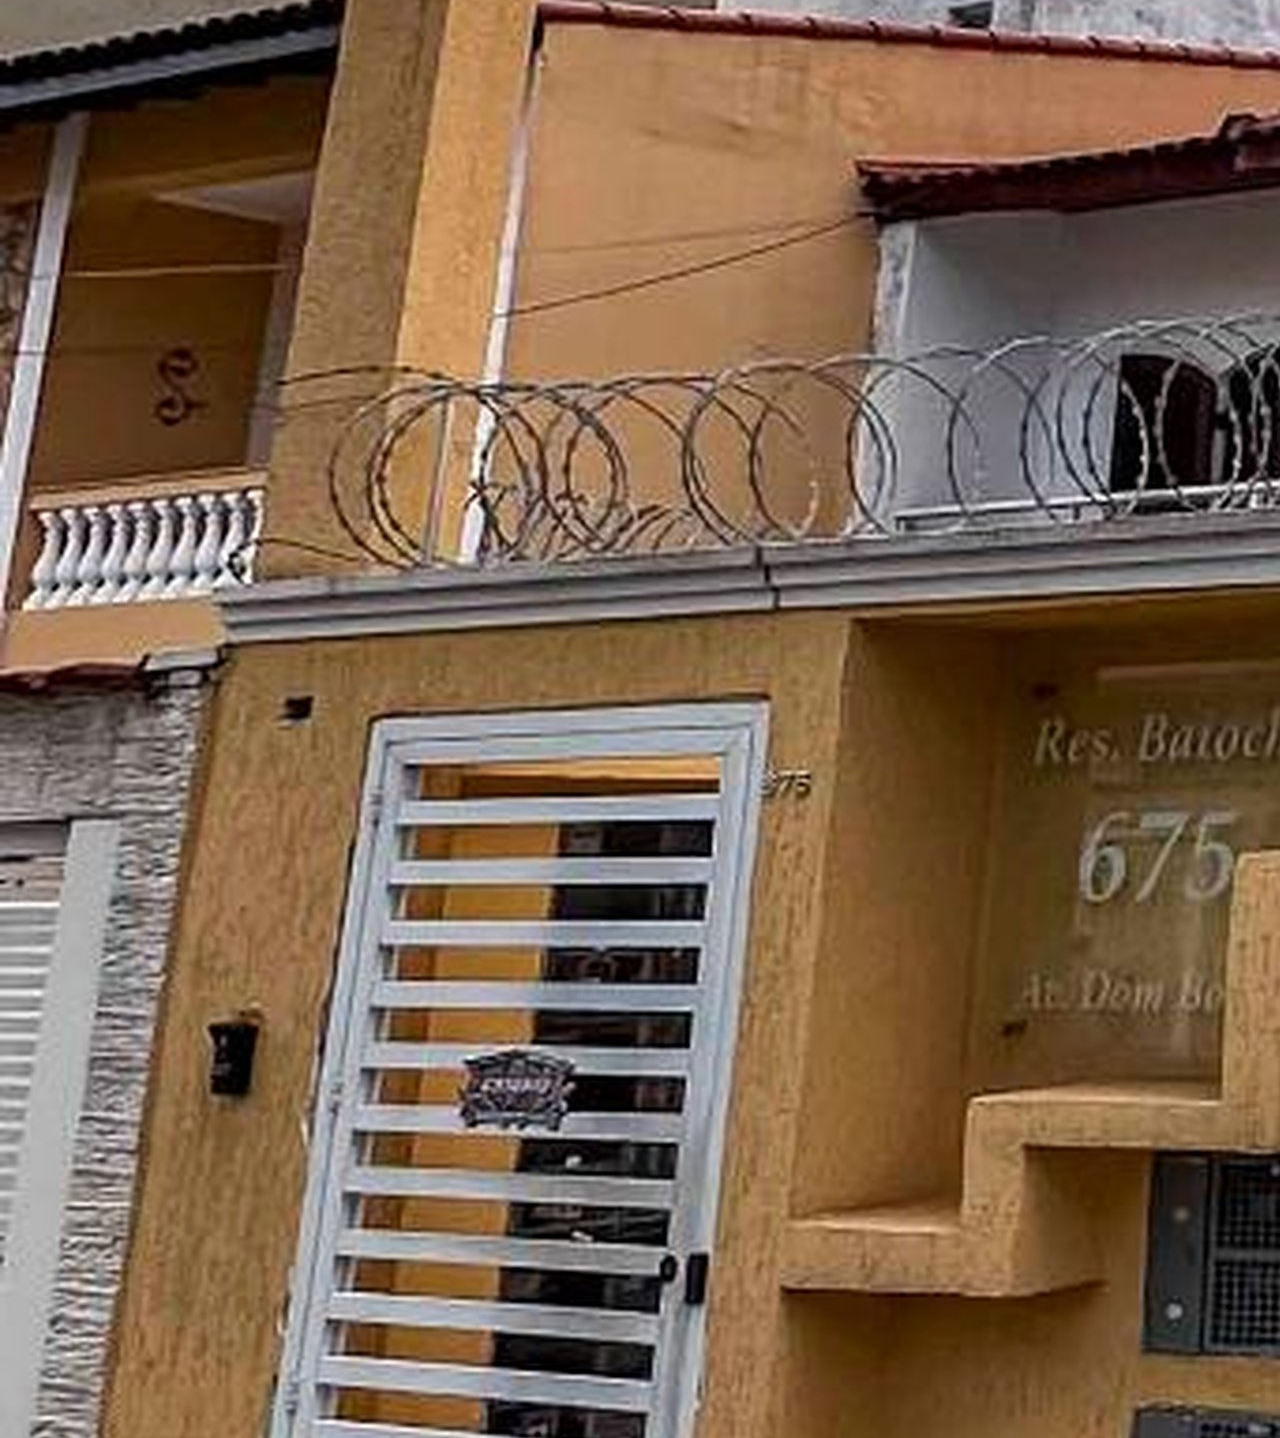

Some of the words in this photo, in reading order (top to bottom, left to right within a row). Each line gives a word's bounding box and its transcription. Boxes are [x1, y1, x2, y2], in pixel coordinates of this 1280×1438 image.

[1031, 715, 1120, 766] Res.
[1078, 810, 1239, 904] 675
[1078, 966, 1164, 1013] Dom
